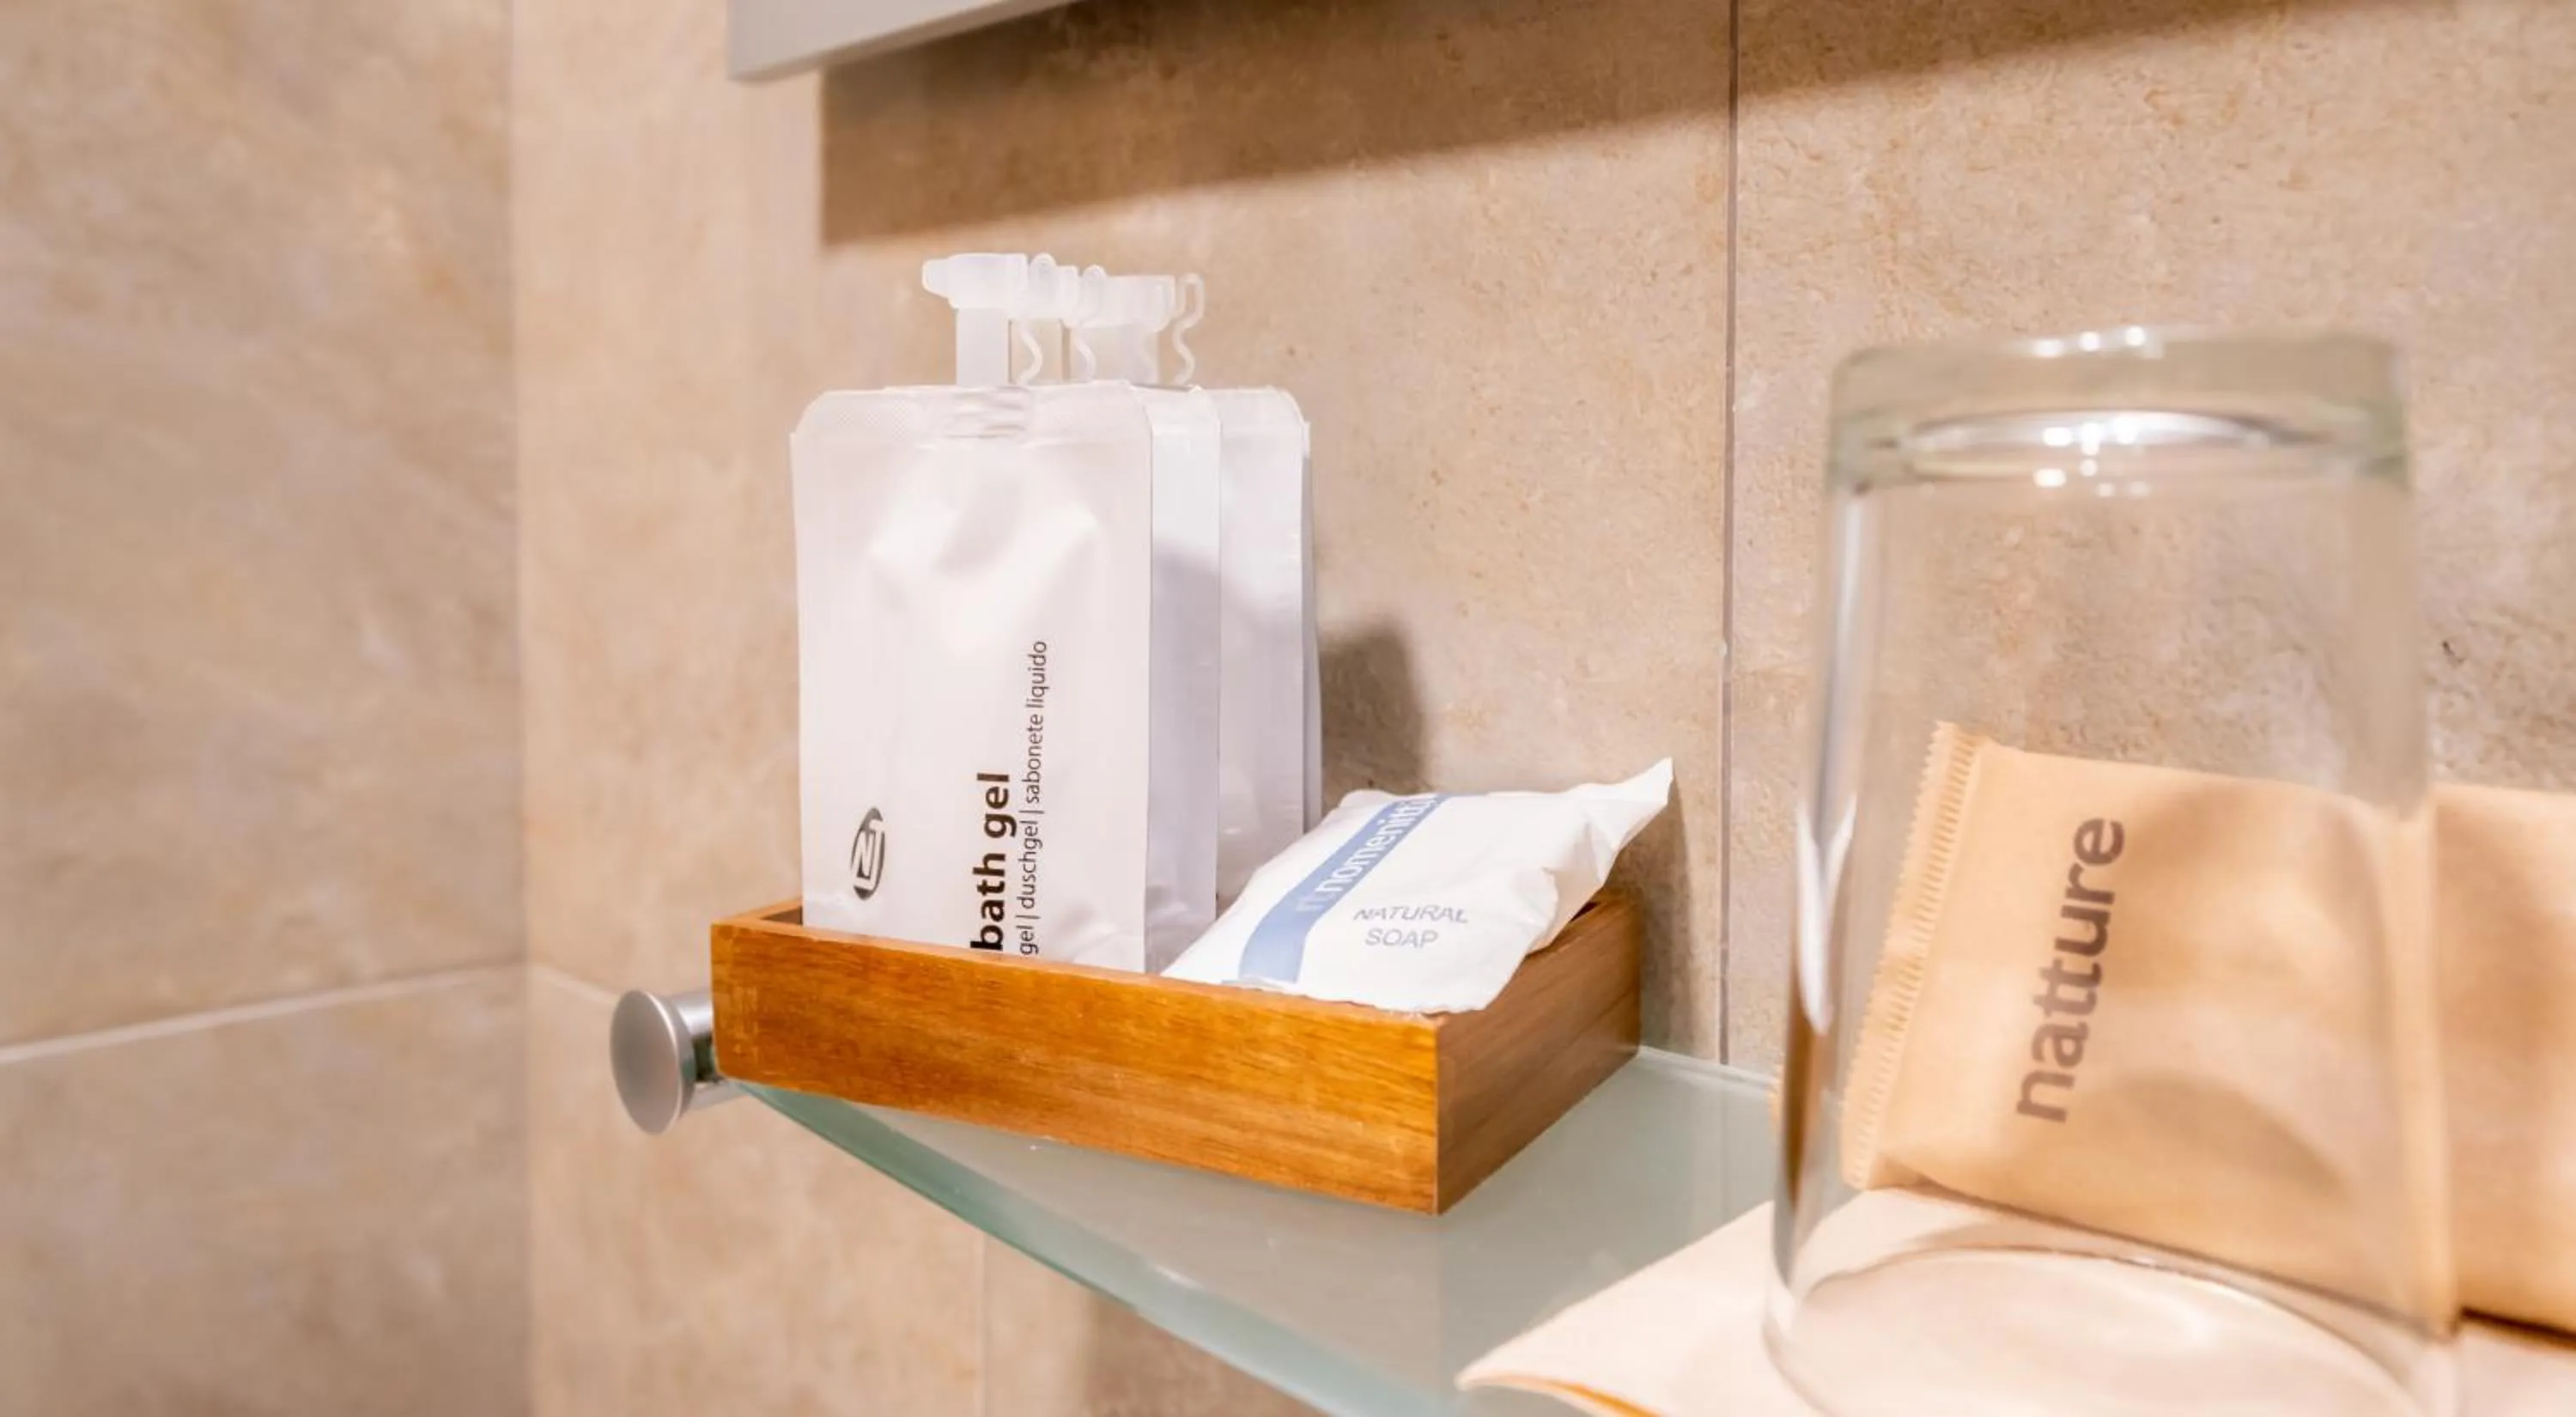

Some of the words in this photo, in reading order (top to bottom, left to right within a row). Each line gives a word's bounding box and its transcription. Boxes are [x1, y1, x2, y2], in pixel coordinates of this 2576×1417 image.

[1022, 714, 1044, 804] sabonete
[976, 773, 1016, 838] gel
[970, 852, 1005, 951] bath
[1017, 820, 1042, 909] duschgel
[1017, 924, 1038, 955] gel
[1352, 905, 1468, 924] NATURAL
[1364, 928, 1439, 948] SOAP
[2017, 818, 2125, 1122] natture
